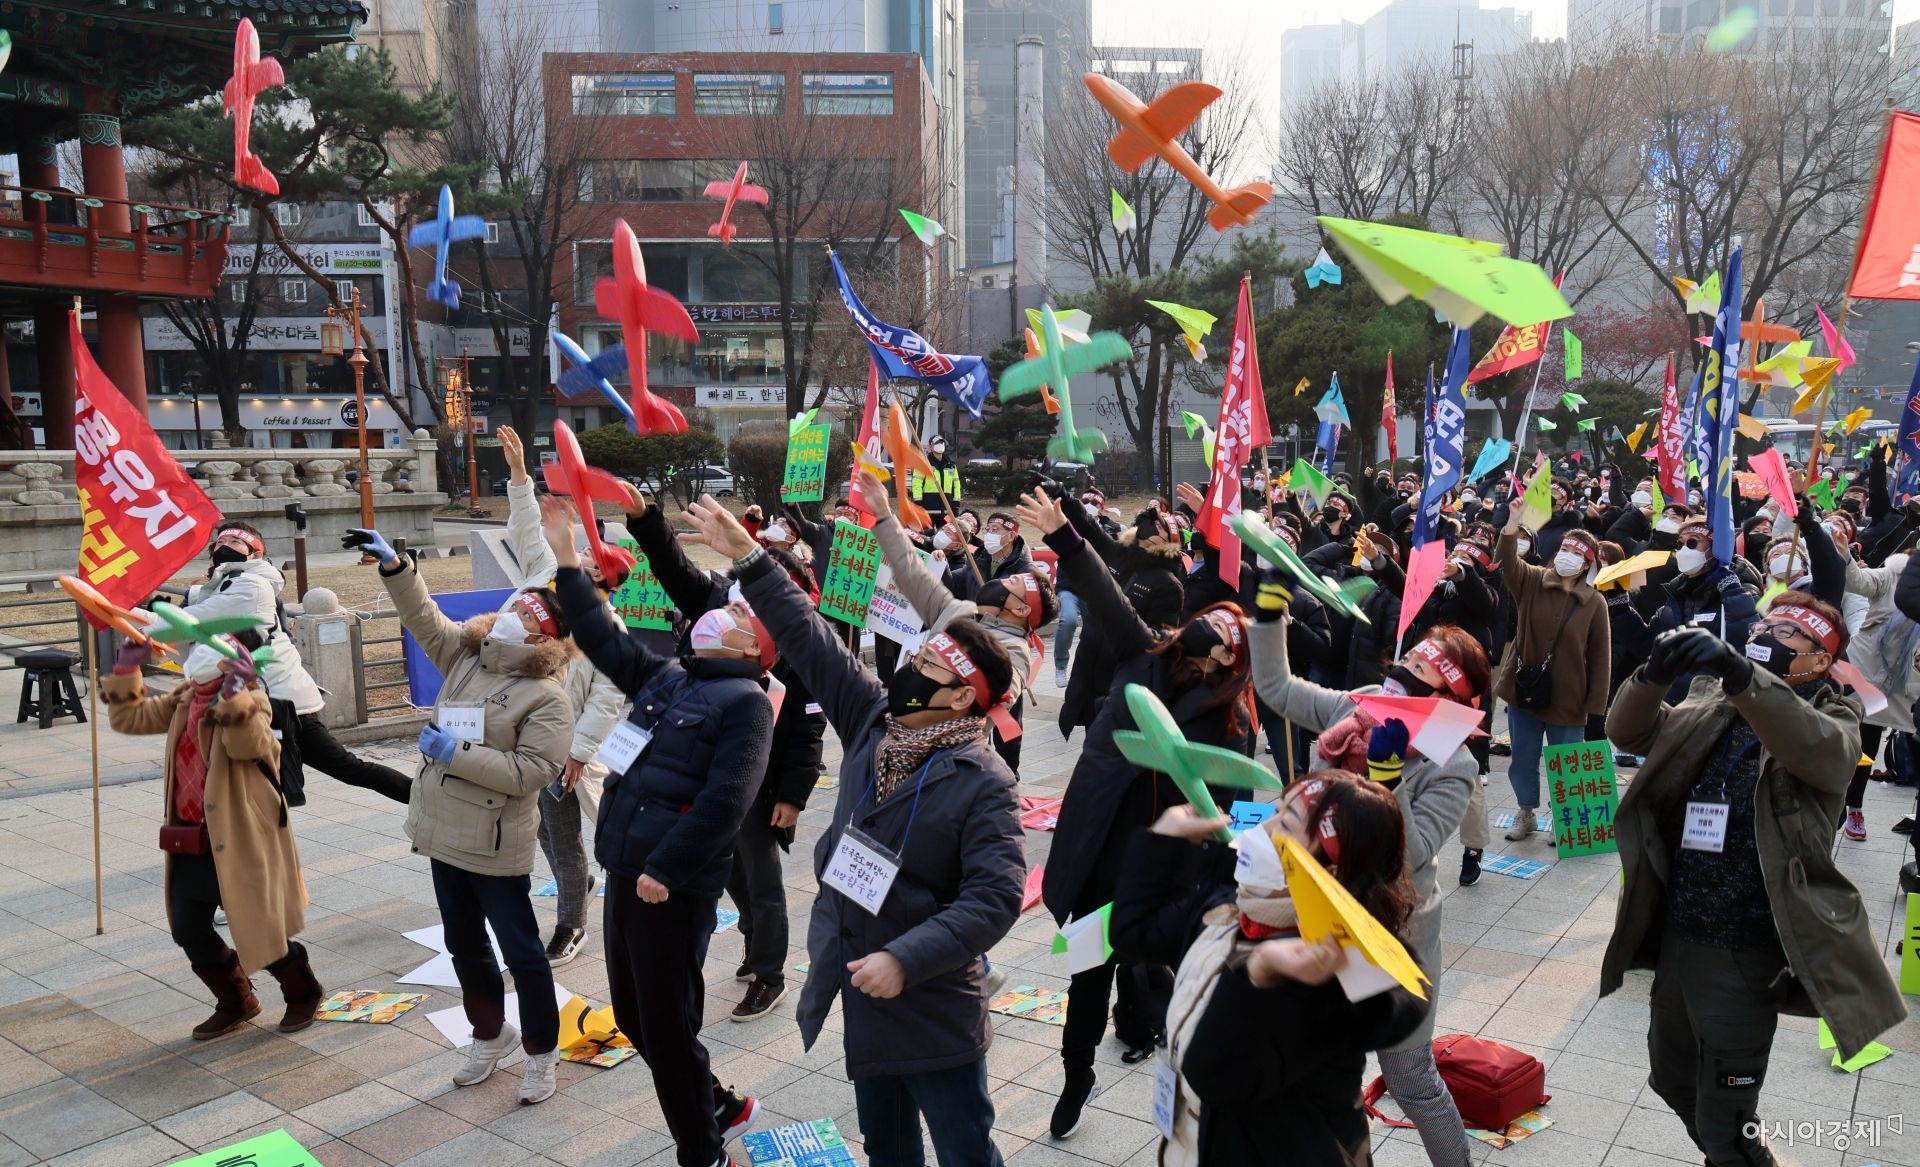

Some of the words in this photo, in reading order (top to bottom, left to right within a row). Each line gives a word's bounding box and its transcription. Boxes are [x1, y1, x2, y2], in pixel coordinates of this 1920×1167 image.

[227, 254, 252, 268] ne
[263, 416, 290, 425] Coffee
[302, 416, 331, 426] Dessert
[1802, 613, 1832, 638] 지원
[945, 648, 976, 678] 지원
[1435, 657, 1463, 684] 지원
[1549, 749, 1605, 776] 여행업을
[1553, 777, 1612, 804] 홀대하는
[1558, 801, 1610, 827] 홍남기
